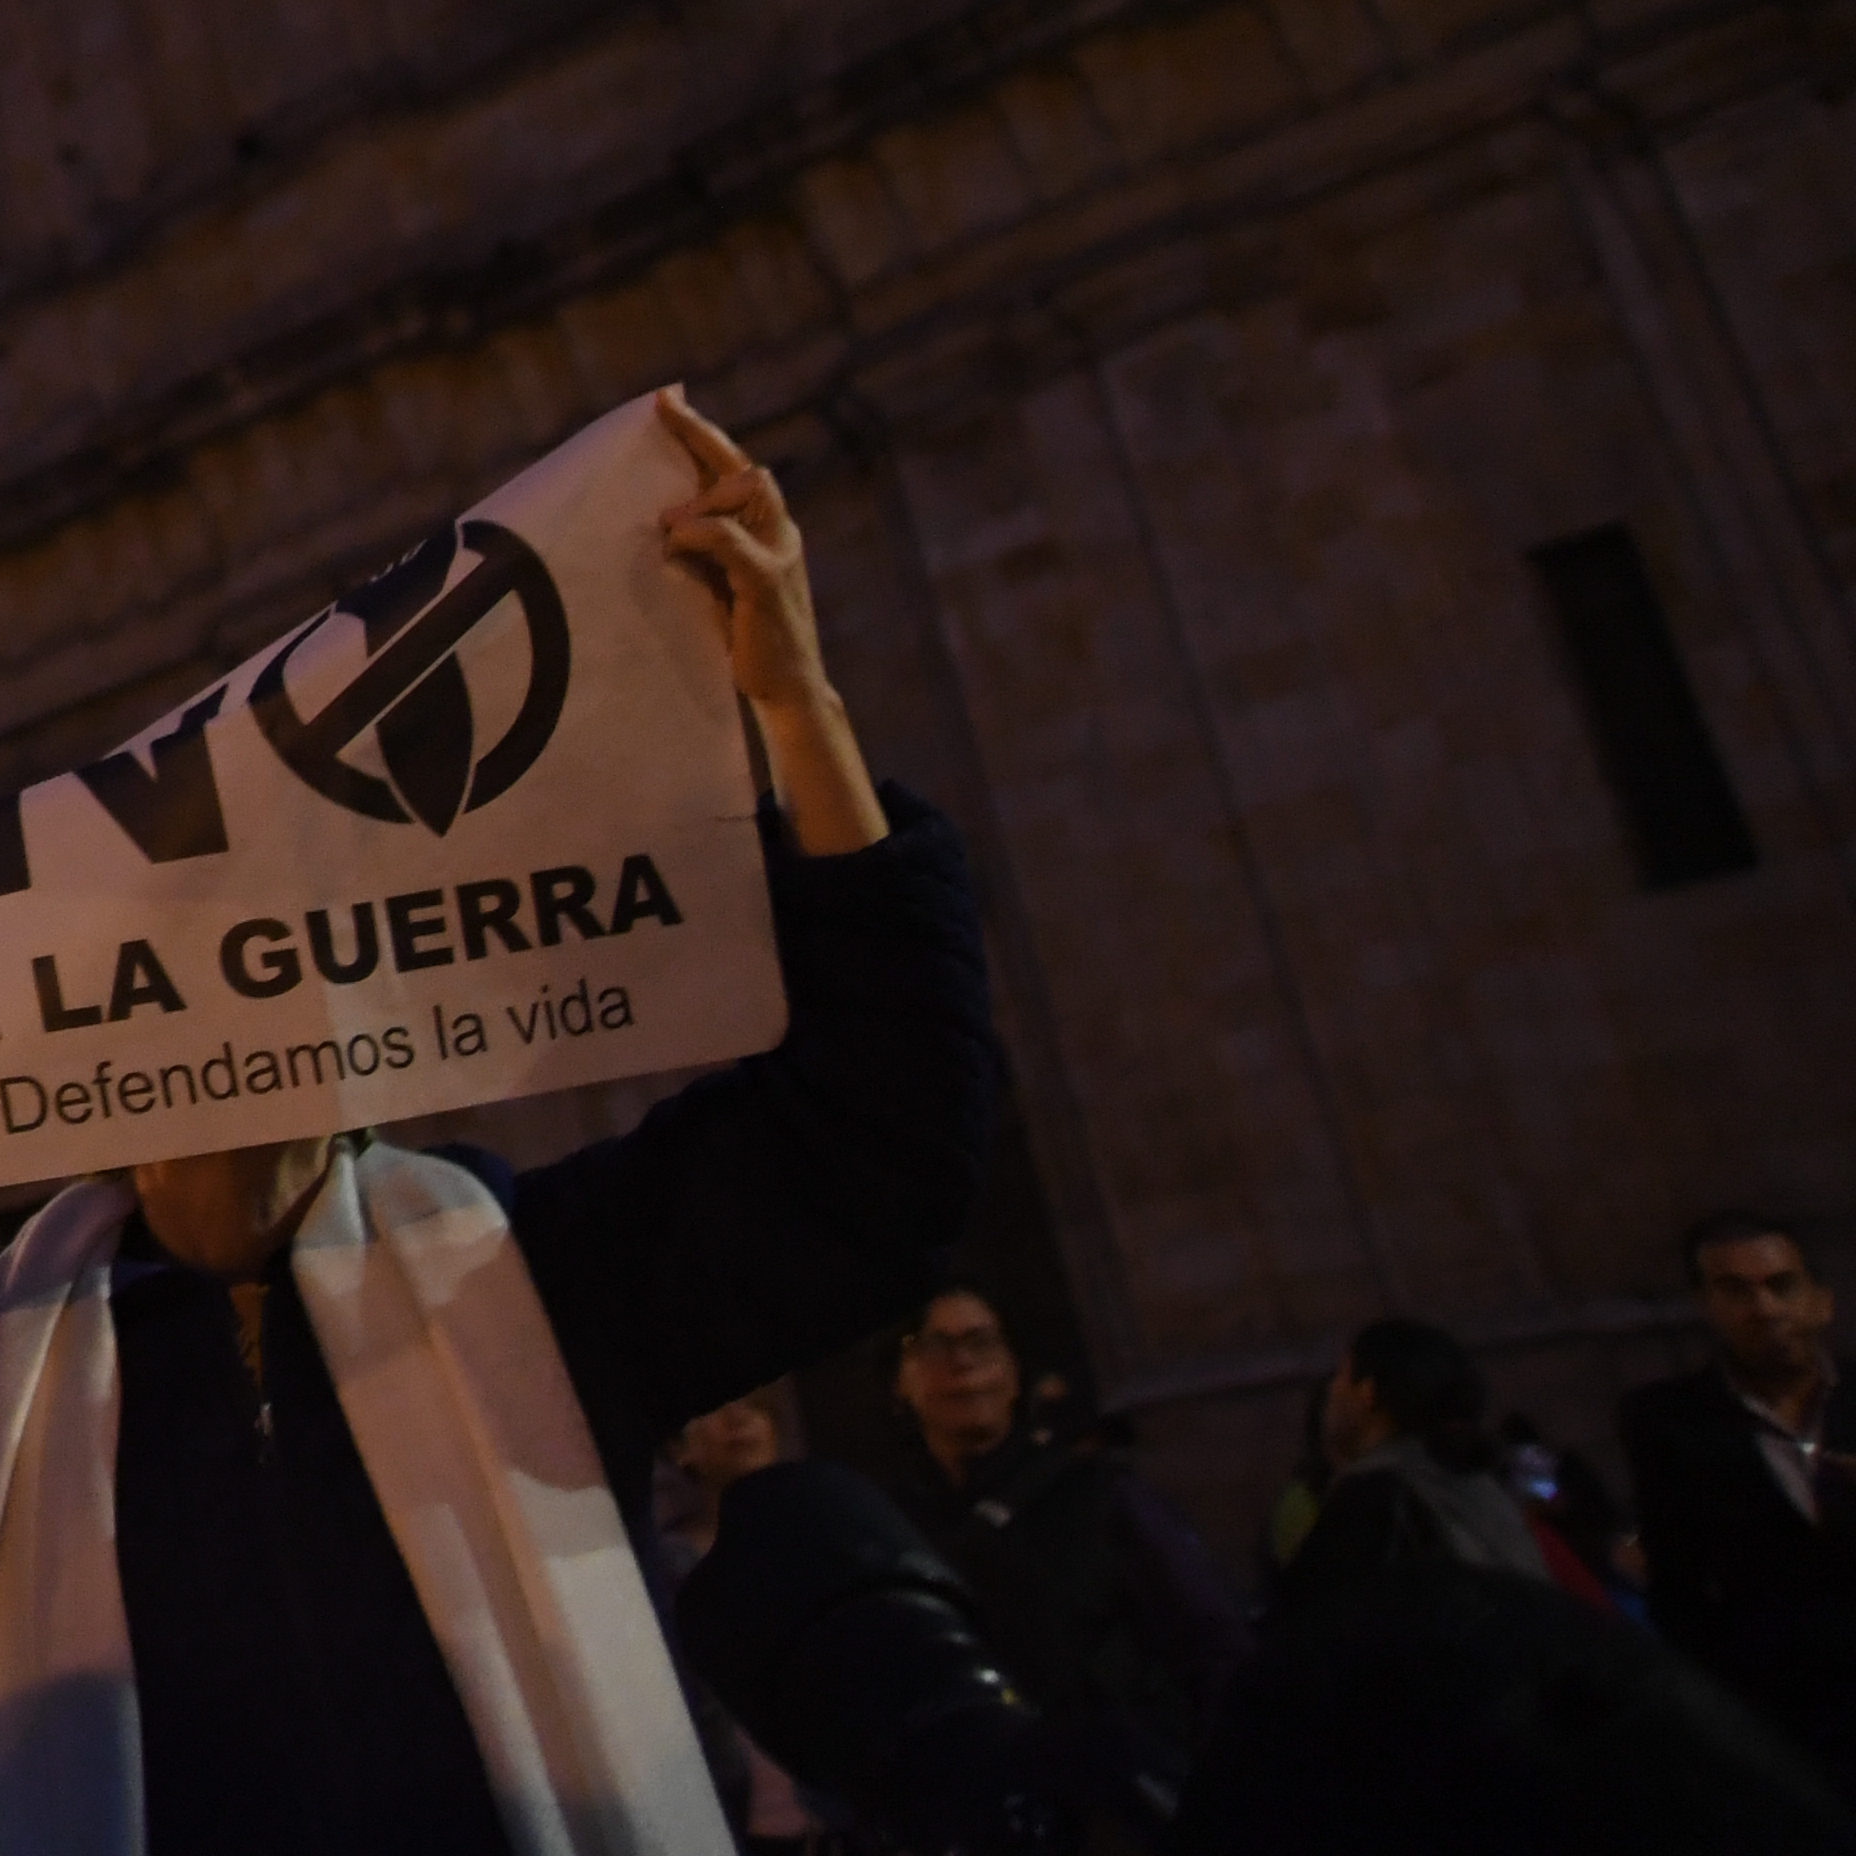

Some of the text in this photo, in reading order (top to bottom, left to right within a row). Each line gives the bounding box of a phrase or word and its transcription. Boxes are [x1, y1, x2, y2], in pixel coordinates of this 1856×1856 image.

[33, 939, 186, 1032] LA
[219, 854, 684, 998] GUERRA
[0, 978, 634, 1134] Defendamos la vida
